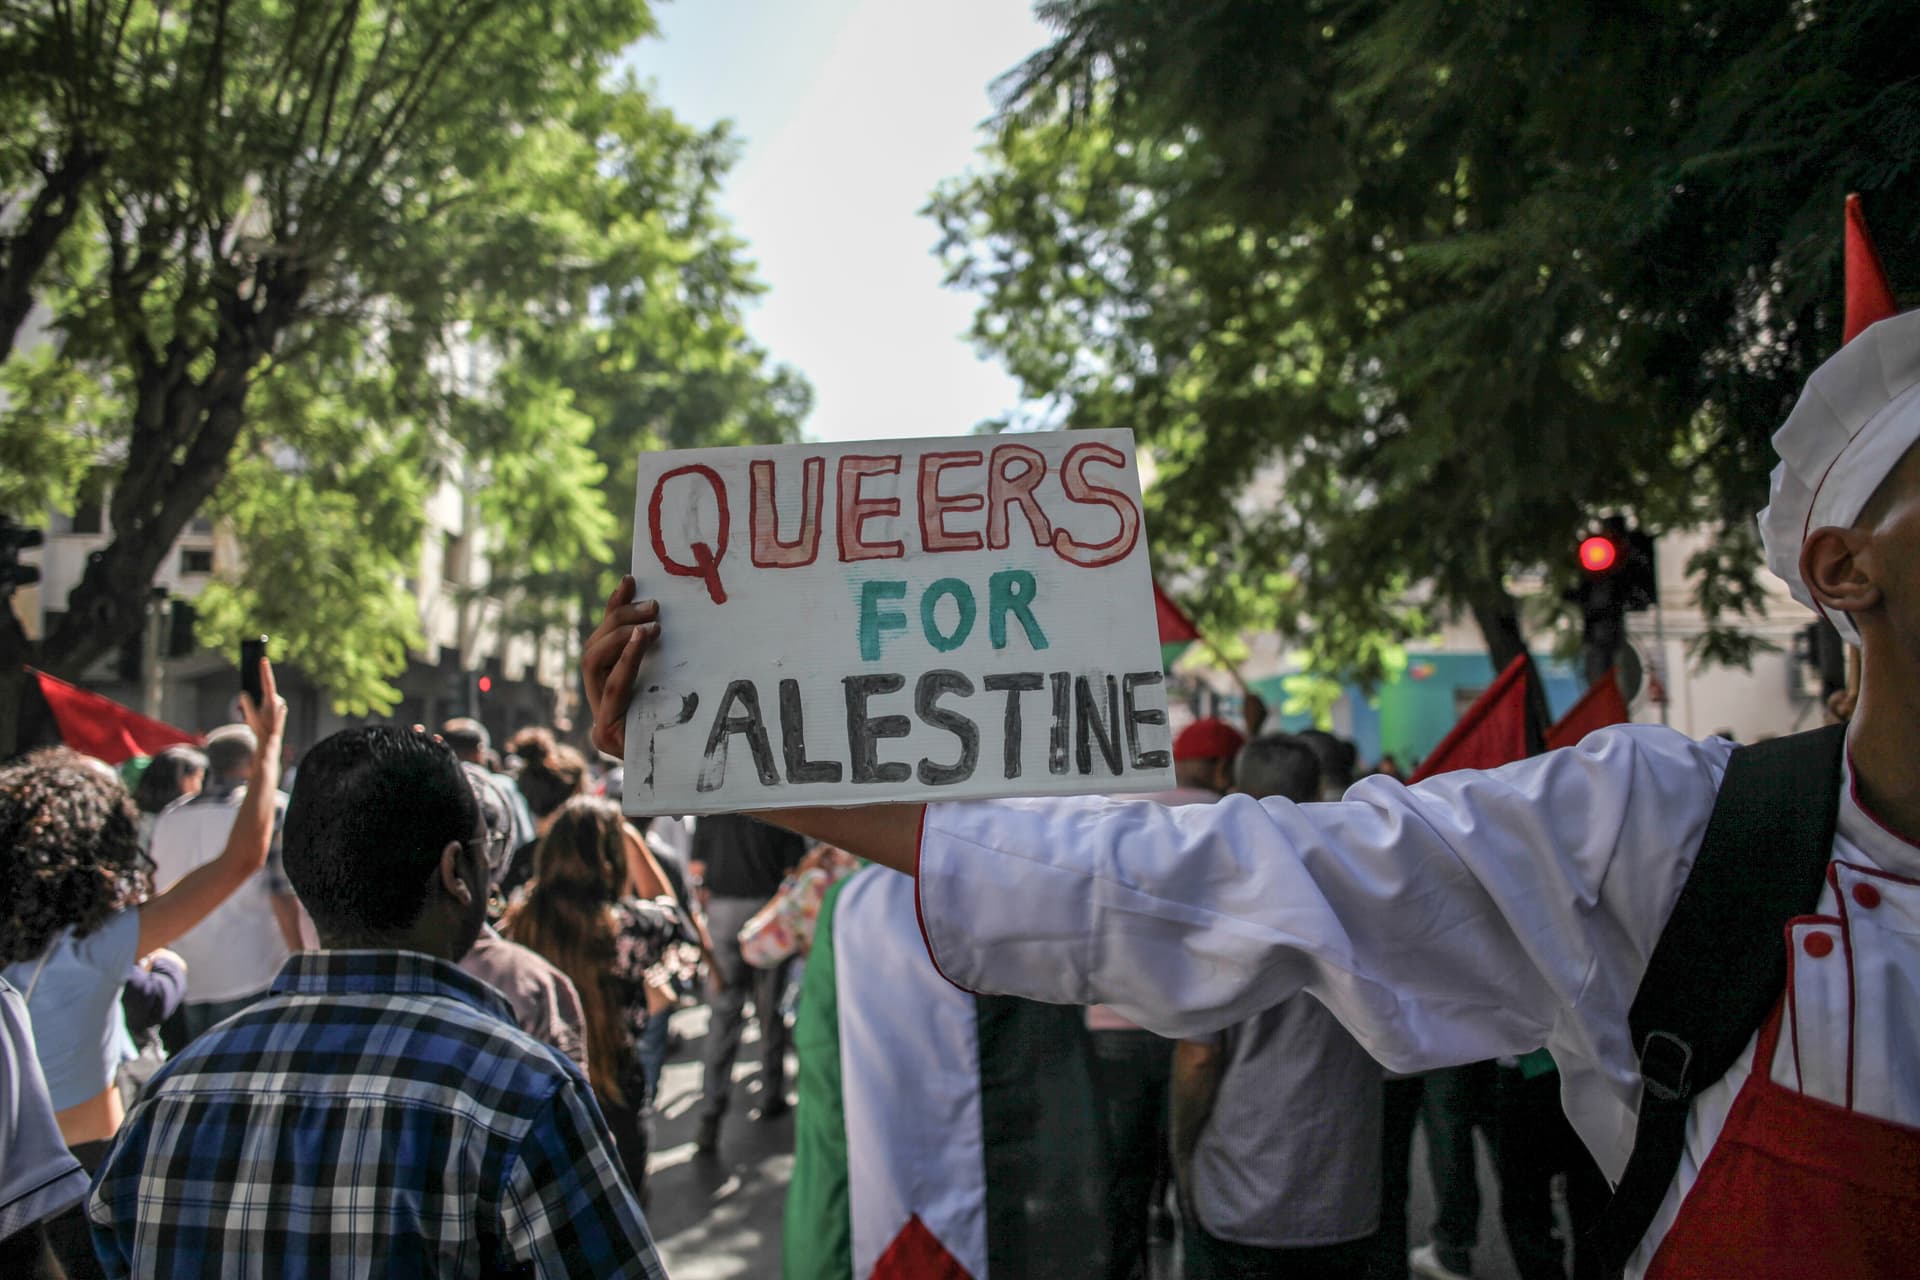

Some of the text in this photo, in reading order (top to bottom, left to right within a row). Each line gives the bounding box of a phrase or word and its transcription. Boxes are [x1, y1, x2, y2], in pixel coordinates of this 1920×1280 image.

[648, 443, 1140, 604] QUEERS
[858, 569, 1049, 661] FOR
[638, 669, 1170, 797] PALESTINE
